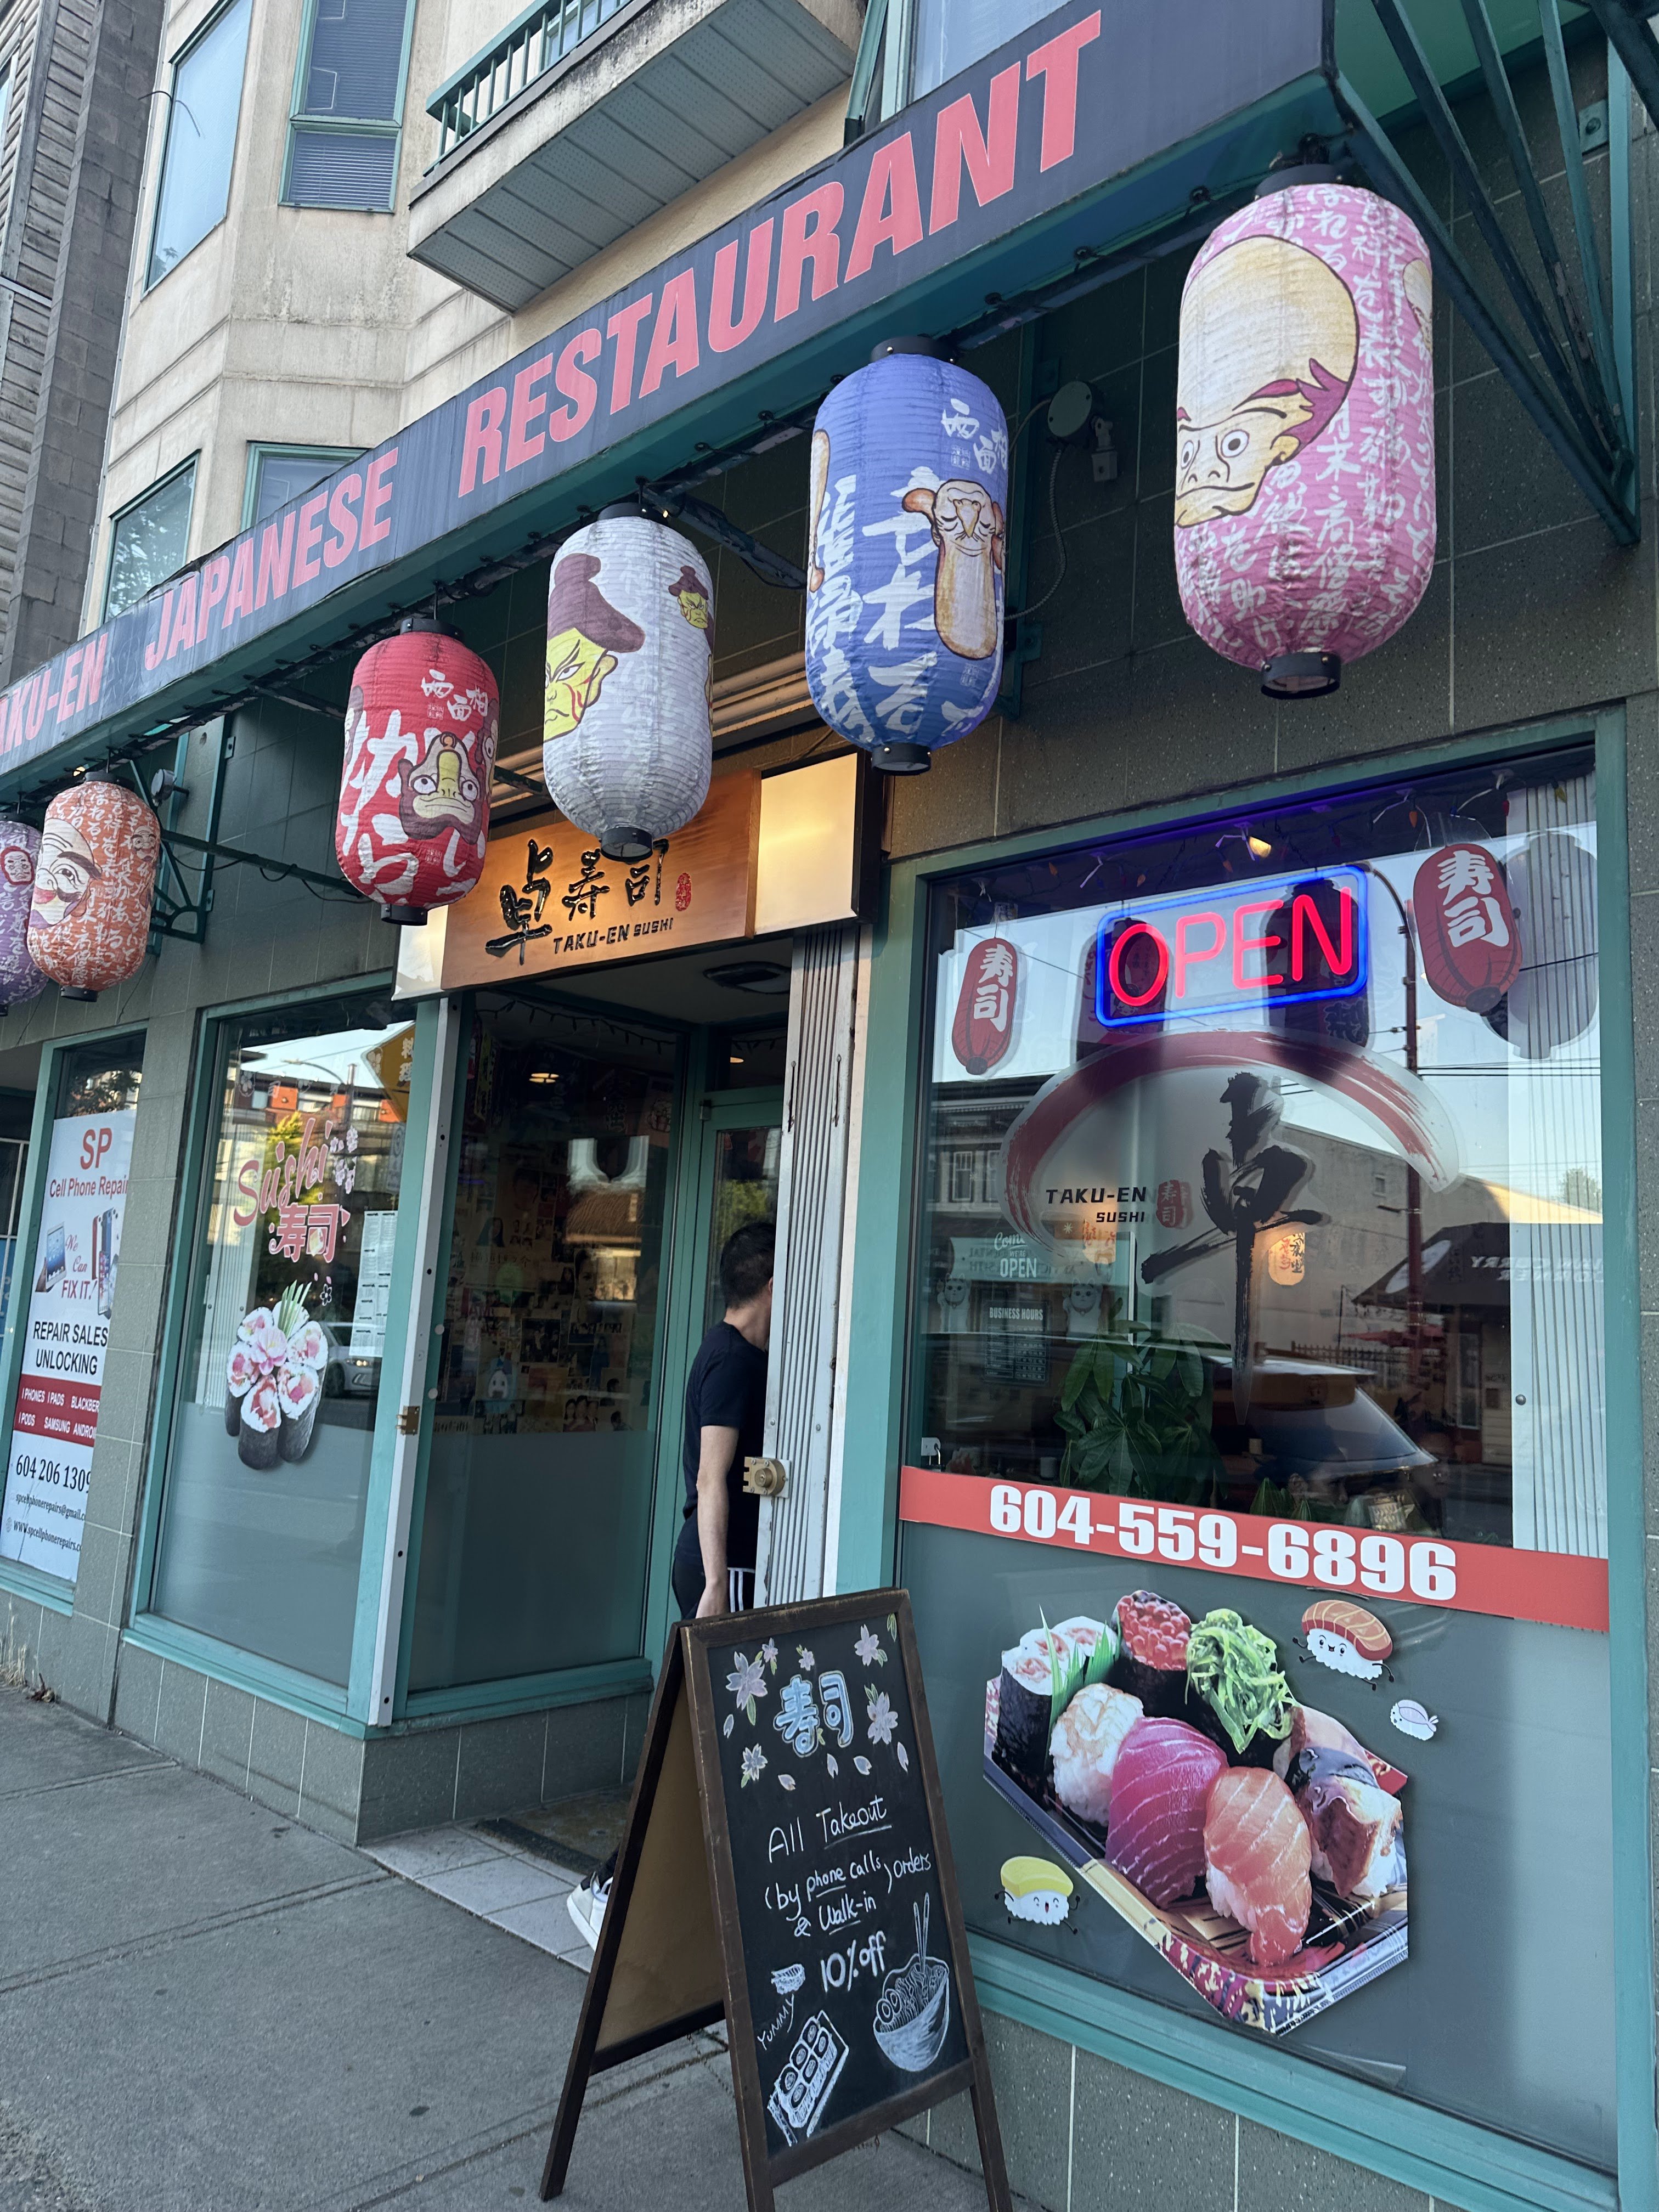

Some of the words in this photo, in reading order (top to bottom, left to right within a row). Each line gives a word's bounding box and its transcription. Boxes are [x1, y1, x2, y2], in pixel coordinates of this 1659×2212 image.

[145, 447, 398, 670] JAPANESE
[458, 9, 1101, 498] RESTAURANT
[1437, 850, 1509, 947] 寿司
[554, 924, 630, 954] TAKU-EN
[634, 918, 674, 936] SUSHI
[1109, 887, 1352, 1007] OPEN
[974, 944, 1013, 1032] 寿司
[80, 1127, 112, 1170] SP
[50, 1178, 66, 1198] Cell
[67, 1177, 96, 1197] Phone
[234, 1118, 333, 1227] Sushi
[1046, 1187, 1147, 1204] TAKU-EN
[269, 1203, 340, 1263] 寿司
[1096, 1211, 1144, 1222] SUSHI
[65, 1234, 78, 1251] We
[73, 1255, 87, 1272] Can
[1000, 1257, 1037, 1278] OPEN
[61, 1280, 78, 1299] FIX
[80, 1280, 98, 1300] IT!
[989, 1307, 1020, 1319] BUSINESS
[1021, 1308, 1043, 1321] HOURS
[33, 1321, 70, 1342] REPAIR
[72, 1324, 108, 1347] SALES
[36, 1348, 98, 1375] UNLOCKING
[44, 1417, 70, 1434] SAMSUNG
[16, 1454, 36, 1479] 604
[38, 1459, 60, 1485] 206
[16, 1493, 86, 1521] spcellphonerepairs@gmail.c
[989, 1484, 1457, 1600] 604-559-6896
[774, 1670, 854, 1757] 寿司
[769, 1816, 804, 1863] All
[816, 1795, 887, 1843] Takeout
[807, 1867, 846, 1902] phone
[894, 1847, 932, 1878] orders
[819, 1891, 877, 1931] Walk-in
